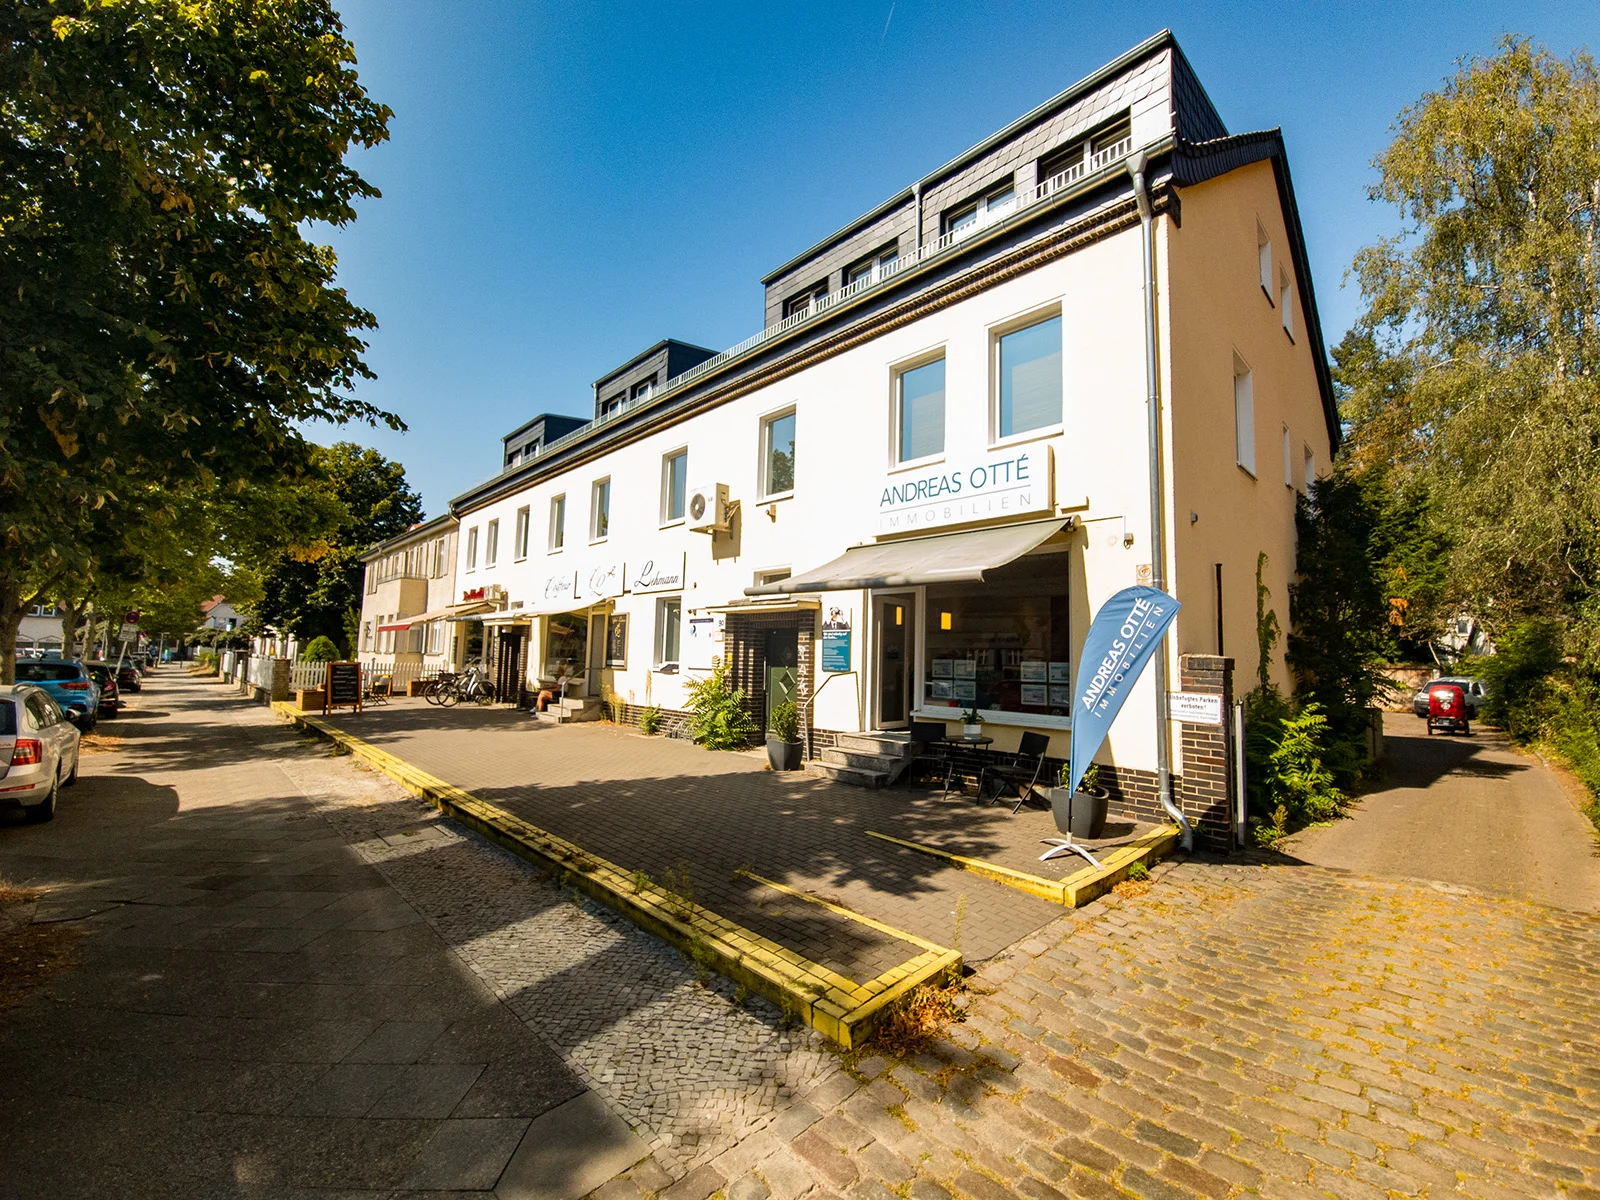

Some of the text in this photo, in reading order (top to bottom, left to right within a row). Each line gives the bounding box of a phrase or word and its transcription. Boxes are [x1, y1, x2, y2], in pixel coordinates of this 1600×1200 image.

[880, 454, 1030, 507] ANDREAS OTTÉ
[880, 493, 1032, 529] IMMOBILIEN
[634, 560, 680, 587] Lehmann
[1081, 596, 1151, 710] ANDREAS OTTÉ
[1094, 605, 1164, 719] IMMOBILIEN
